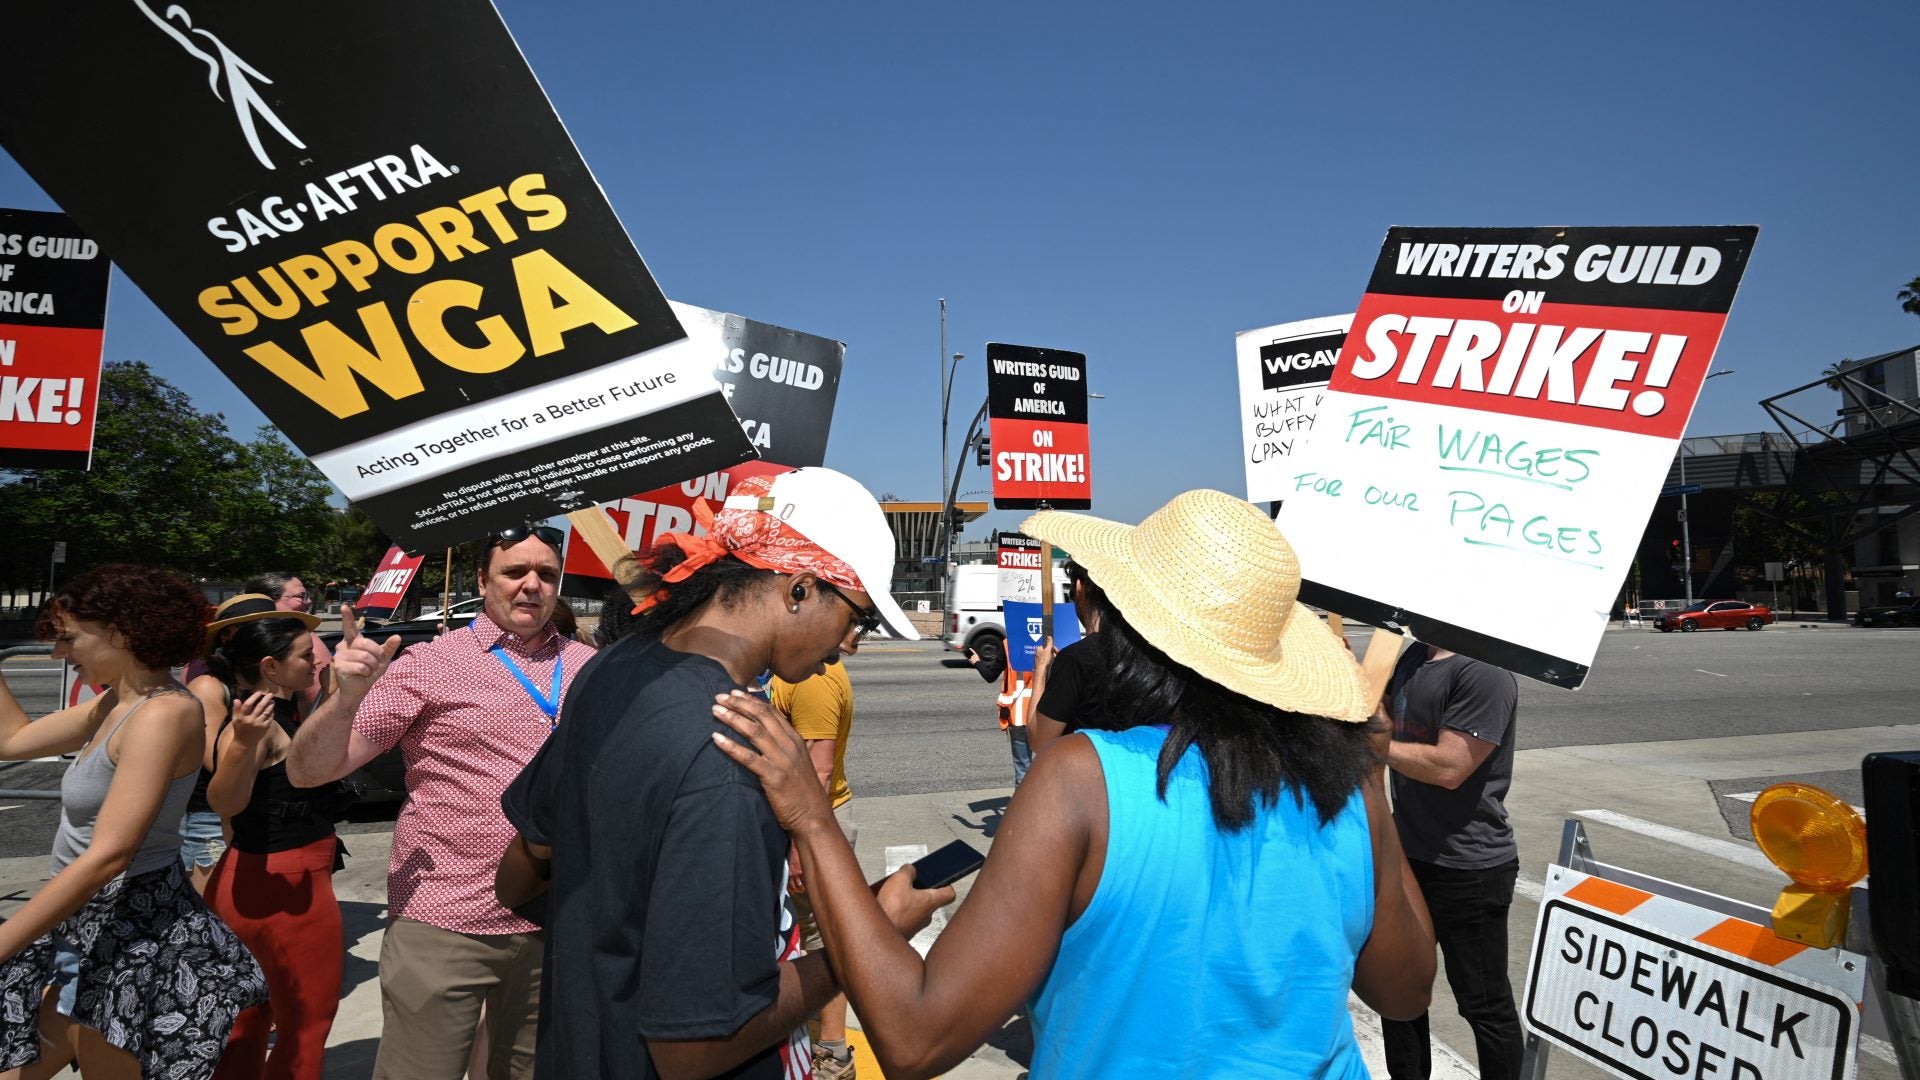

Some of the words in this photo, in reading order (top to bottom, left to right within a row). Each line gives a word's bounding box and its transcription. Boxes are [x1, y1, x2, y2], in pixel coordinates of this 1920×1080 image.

[27, 235, 99, 260] GUILD
[198, 173, 568, 336] SUPPORTS
[1395, 242, 1570, 280] WRITERS
[1573, 244, 1722, 286] GUILD
[1501, 289, 1546, 315] ON
[242, 248, 639, 419] WGA
[749, 352, 824, 391] GUILD
[993, 359, 1047, 378] WRITERS
[1048, 365, 1080, 381] GUILD
[1350, 313, 1688, 417] STRIKE!
[0, 375, 85, 425] KE!
[1033, 382, 1046, 394] OF
[356, 449, 419, 478] Acting
[415, 425, 500, 453] Together
[501, 411, 535, 433] for
[534, 412, 547, 425] a
[546, 392, 606, 420] Better
[608, 370, 677, 401] Future
[1014, 398, 1066, 415] AMERICA
[1253, 395, 1305, 419] WHAT
[1032, 430, 1053, 447] ON
[1255, 413, 1317, 438] BUFFY
[442, 490, 458, 500] No
[458, 480, 493, 496] dispute
[493, 473, 514, 484] with
[514, 468, 530, 480] any
[531, 460, 556, 474] other
[556, 449, 599, 468] employer
[600, 446, 611, 454] at
[611, 439, 631, 451] this
[630, 434, 651, 446] site.
[467, 495, 476, 503] is
[476, 490, 493, 501] not
[492, 480, 523, 495] asking
[523, 476, 540, 488] any
[540, 463, 584, 481] individual
[584, 459, 595, 469] to
[595, 454, 622, 466] cease
[623, 438, 677, 461] performing
[676, 431, 694, 443] any
[997, 451, 1085, 483] STRIKE!
[1438, 423, 1600, 483] WAGES
[410, 513, 449, 530] services,
[448, 511, 458, 519] or
[457, 506, 469, 516] to
[469, 498, 498, 513] refuse
[497, 494, 509, 504] to
[509, 487, 529, 501] pick
[529, 486, 544, 496] up,
[543, 476, 577, 490] deliver,
[576, 466, 608, 481] handle
[608, 464, 619, 472] or
[619, 451, 664, 469] transport
[664, 446, 682, 457] any
[682, 435, 715, 452] goods.
[1293, 472, 1342, 497] FOR
[1448, 490, 1602, 554] PAGES
[1001, 537, 1026, 546] WRITERS
[1000, 551, 1042, 568] STRIKE!
[364, 568, 413, 595] STRIKE!
[1017, 574, 1035, 594] 2%
[1027, 622, 1043, 634] CFT
[1560, 926, 1810, 1060] SIDEWALK
[1574, 990, 1763, 1080] CLOSED
